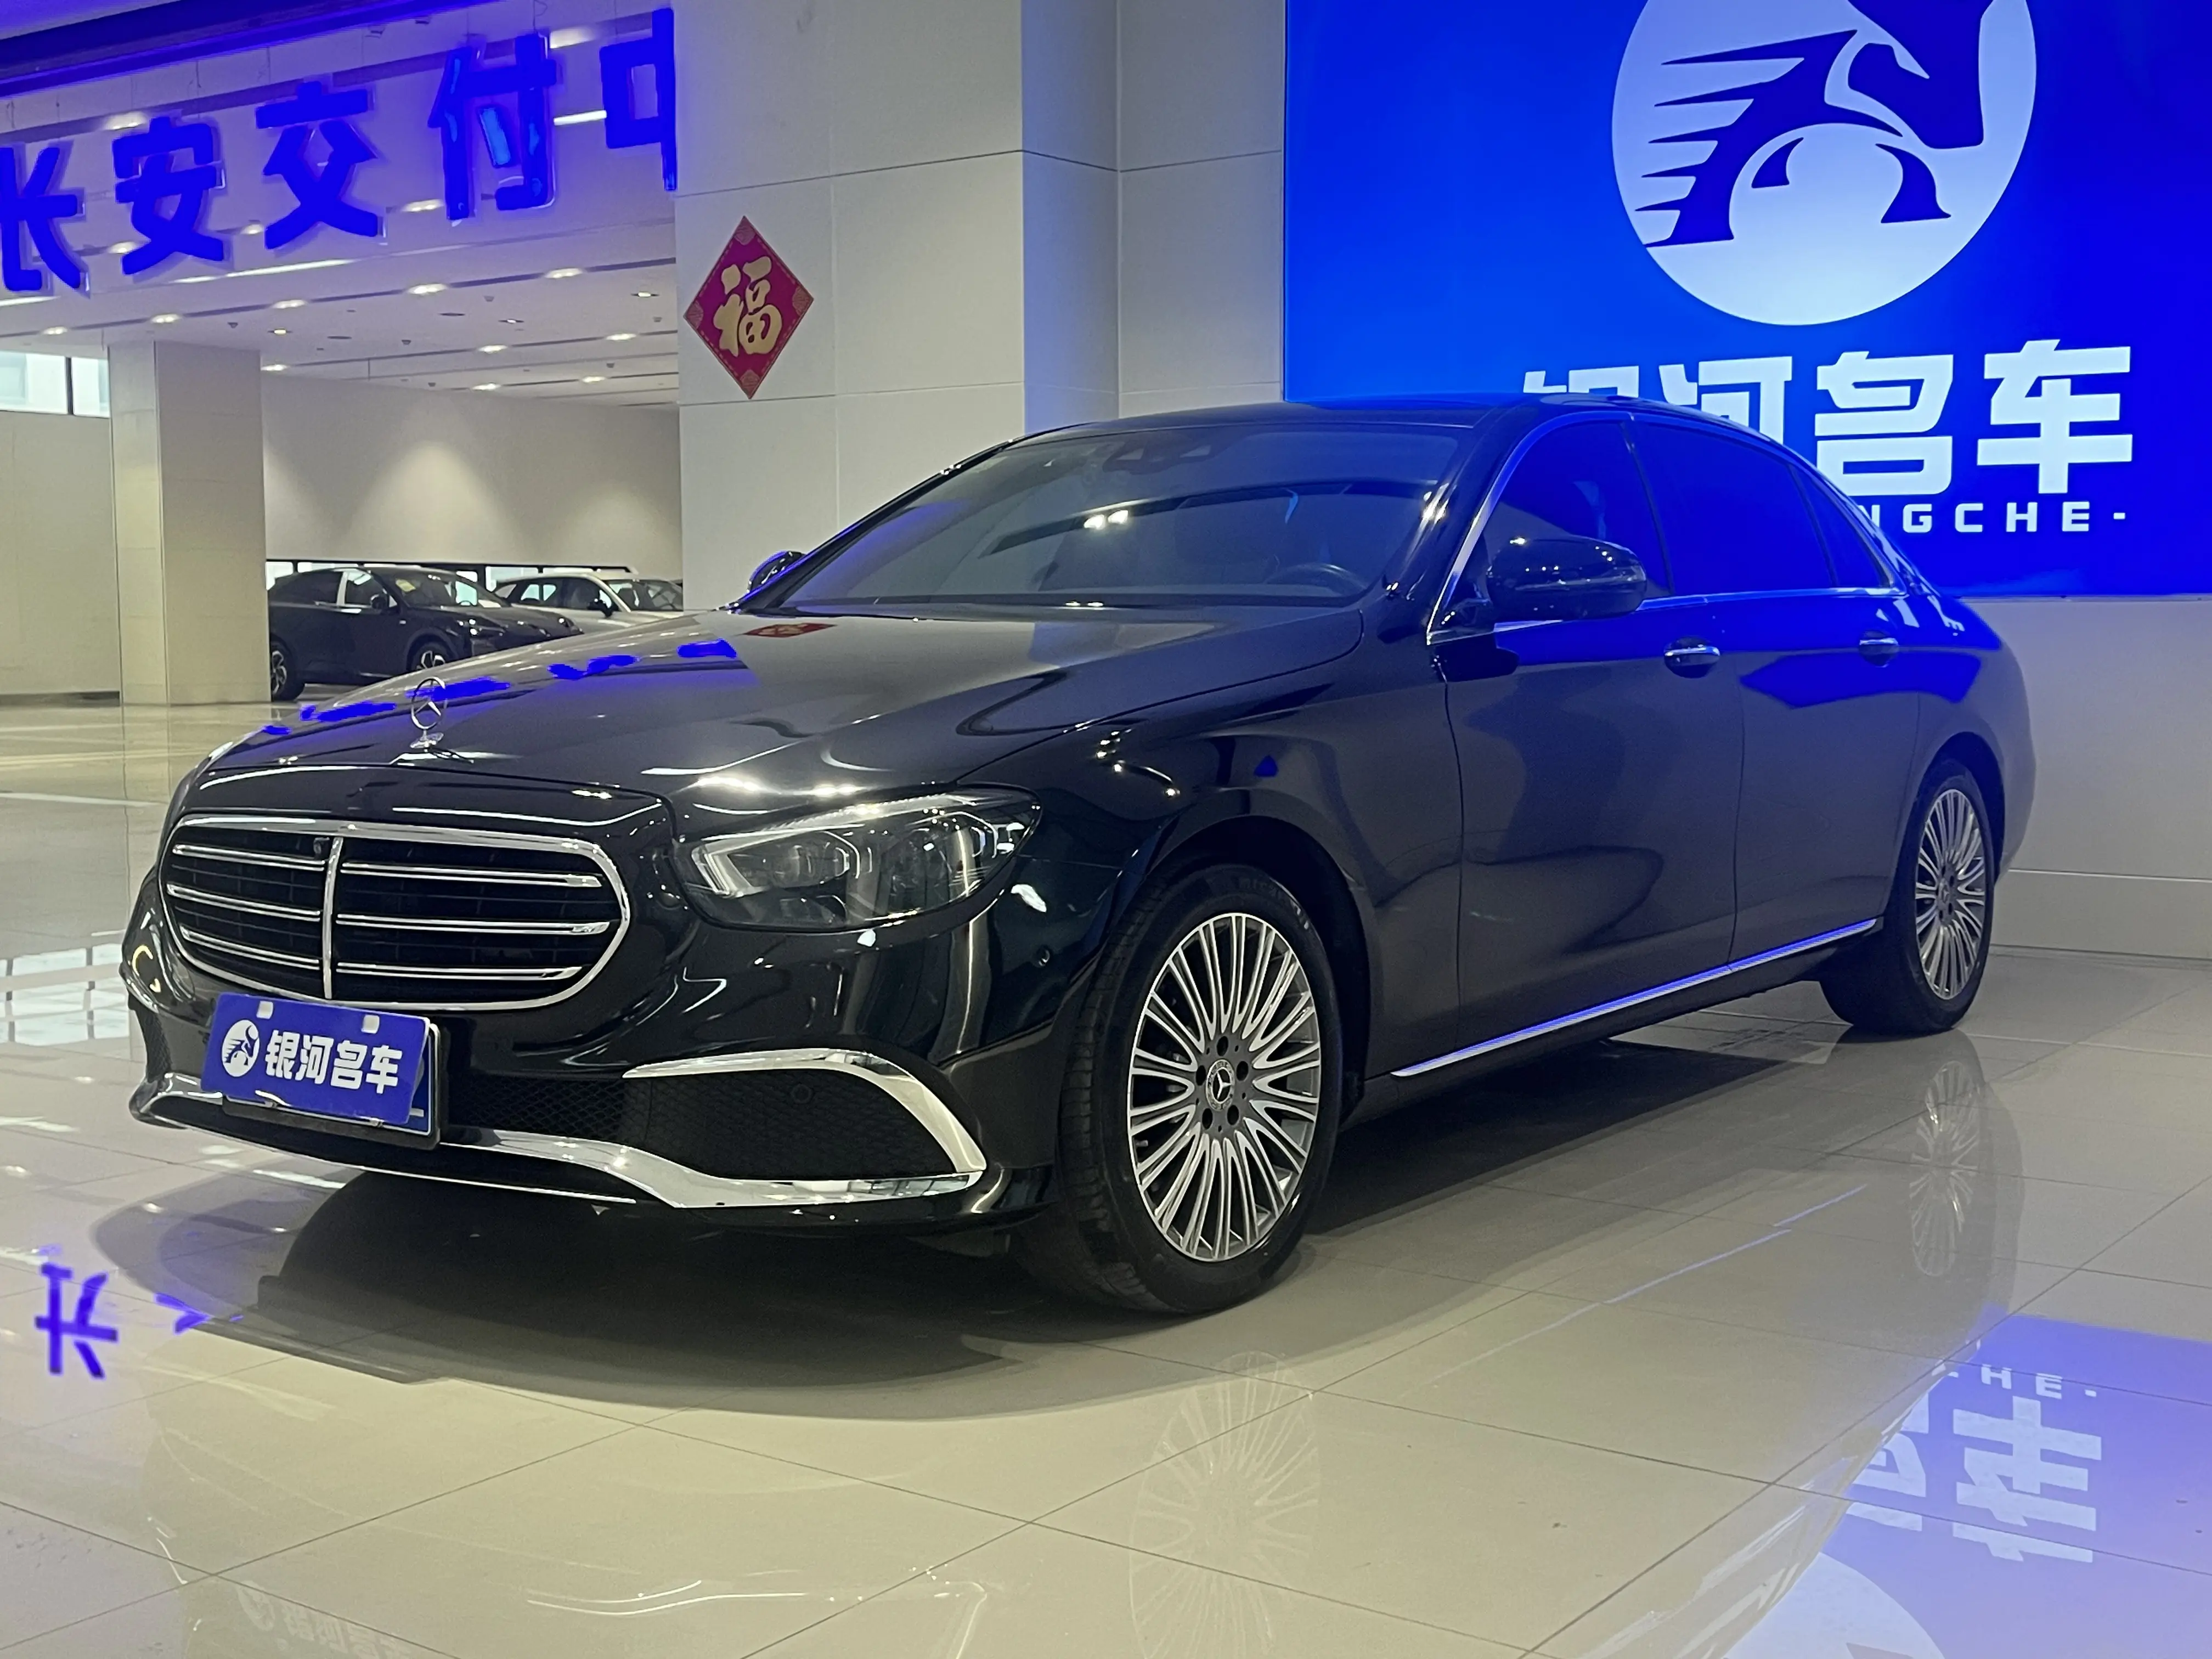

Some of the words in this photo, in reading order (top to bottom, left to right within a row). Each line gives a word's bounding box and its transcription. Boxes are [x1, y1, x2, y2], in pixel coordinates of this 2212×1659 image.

[714, 256, 782, 357] 福
[264, 1030, 402, 1094] 银河名车
